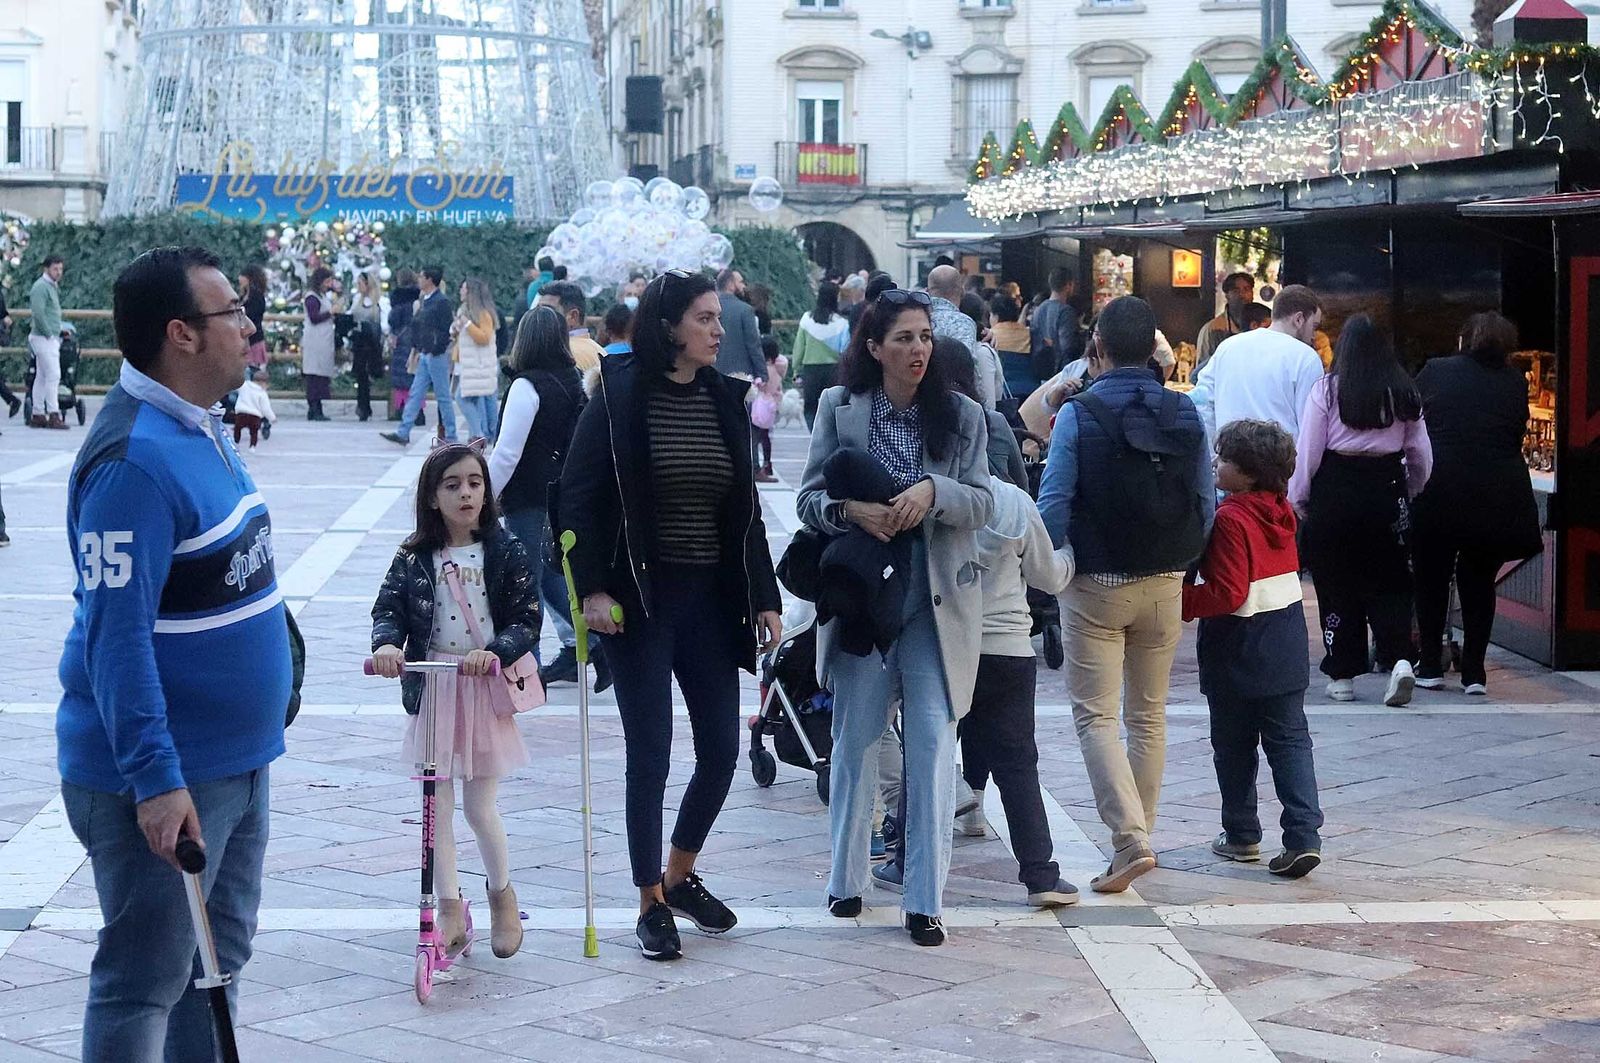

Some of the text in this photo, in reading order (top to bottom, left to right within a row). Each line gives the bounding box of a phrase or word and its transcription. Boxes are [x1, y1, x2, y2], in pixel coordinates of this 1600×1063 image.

[177, 140, 266, 223] La
[337, 151, 400, 199] del
[406, 140, 509, 211] Sur
[338, 208, 412, 226] NAVIDAD
[80, 531, 133, 590] 35
